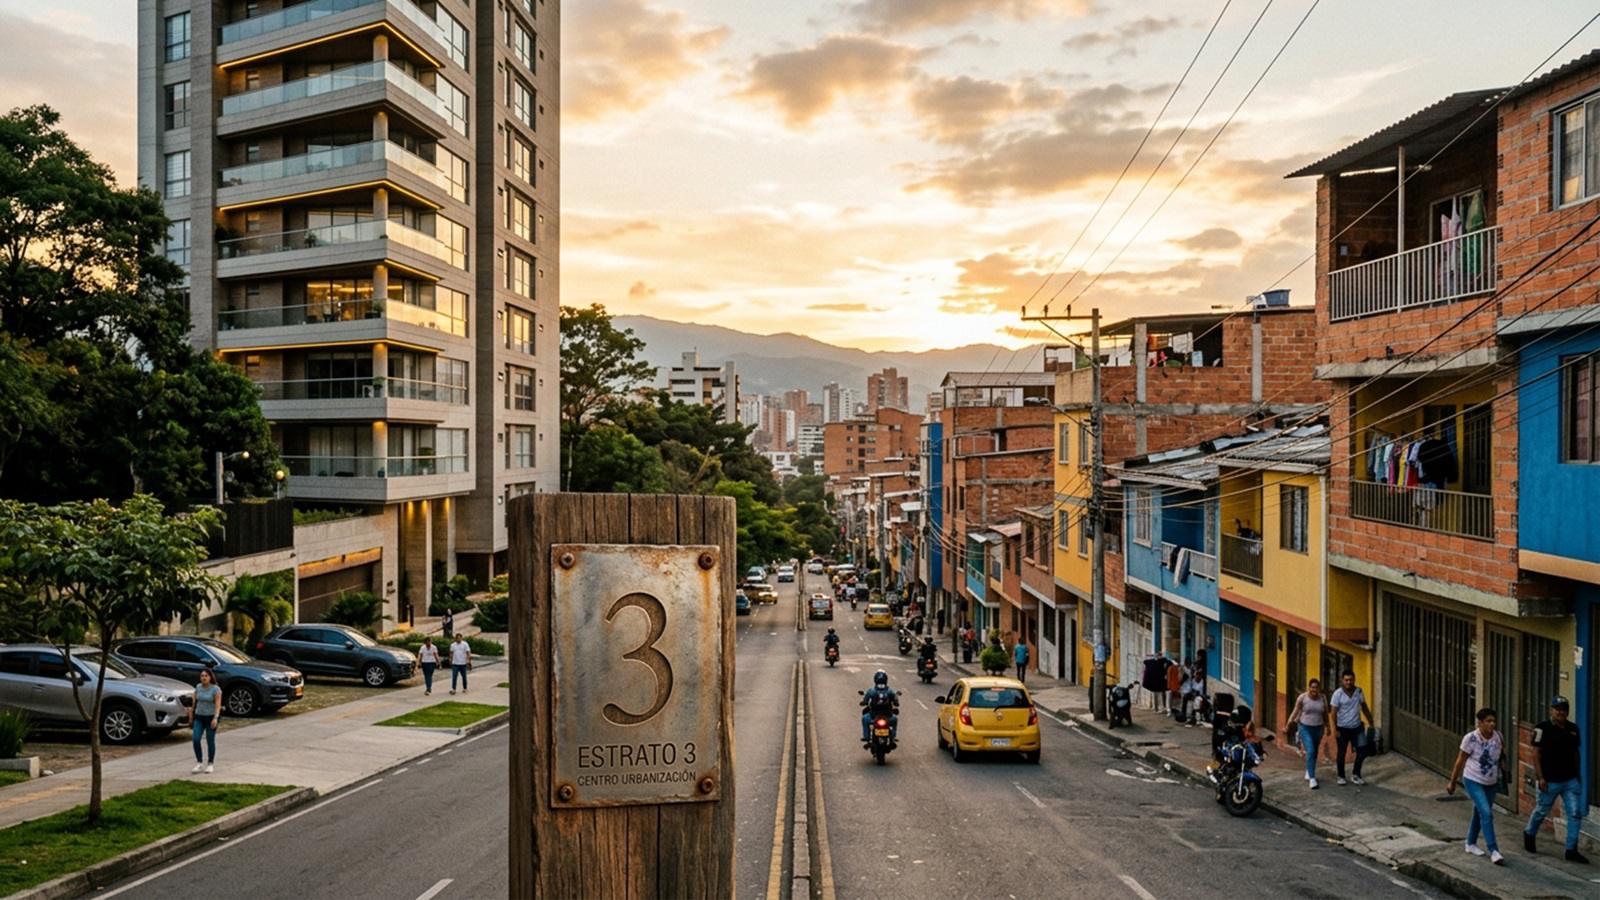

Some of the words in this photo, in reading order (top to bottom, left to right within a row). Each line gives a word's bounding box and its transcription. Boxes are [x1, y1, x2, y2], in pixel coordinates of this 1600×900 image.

[602, 591, 674, 726] 3
[578, 743, 676, 769] ESTRATO
[683, 742, 696, 765] 3
[577, 774, 619, 786] CENTRO
[621, 769, 696, 785] URBANIZACIÓN
